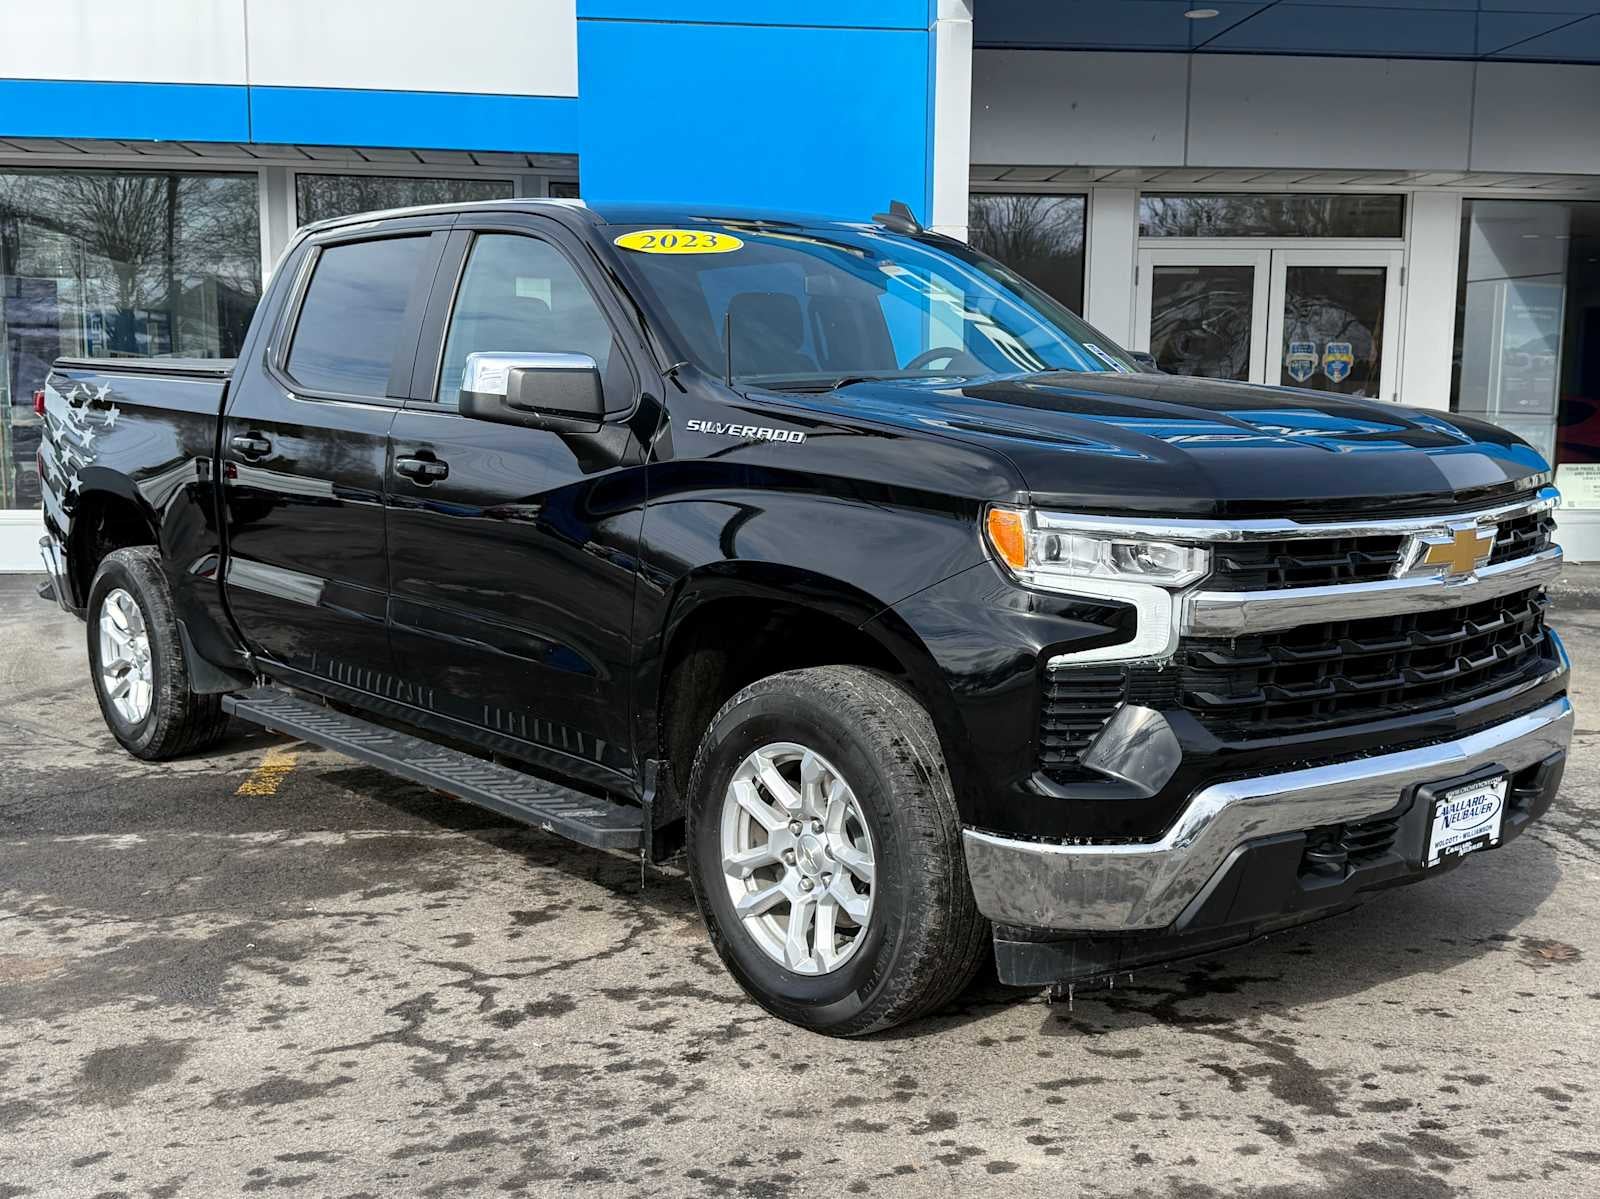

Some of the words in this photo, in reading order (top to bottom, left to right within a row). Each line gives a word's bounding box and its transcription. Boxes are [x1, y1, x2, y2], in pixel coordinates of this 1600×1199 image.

[640, 234, 718, 249] 2023
[686, 419, 807, 444] SILVERADO
[1434, 835, 1459, 849] WOLCOTT
[1462, 825, 1493, 839] WILLIAMSON
